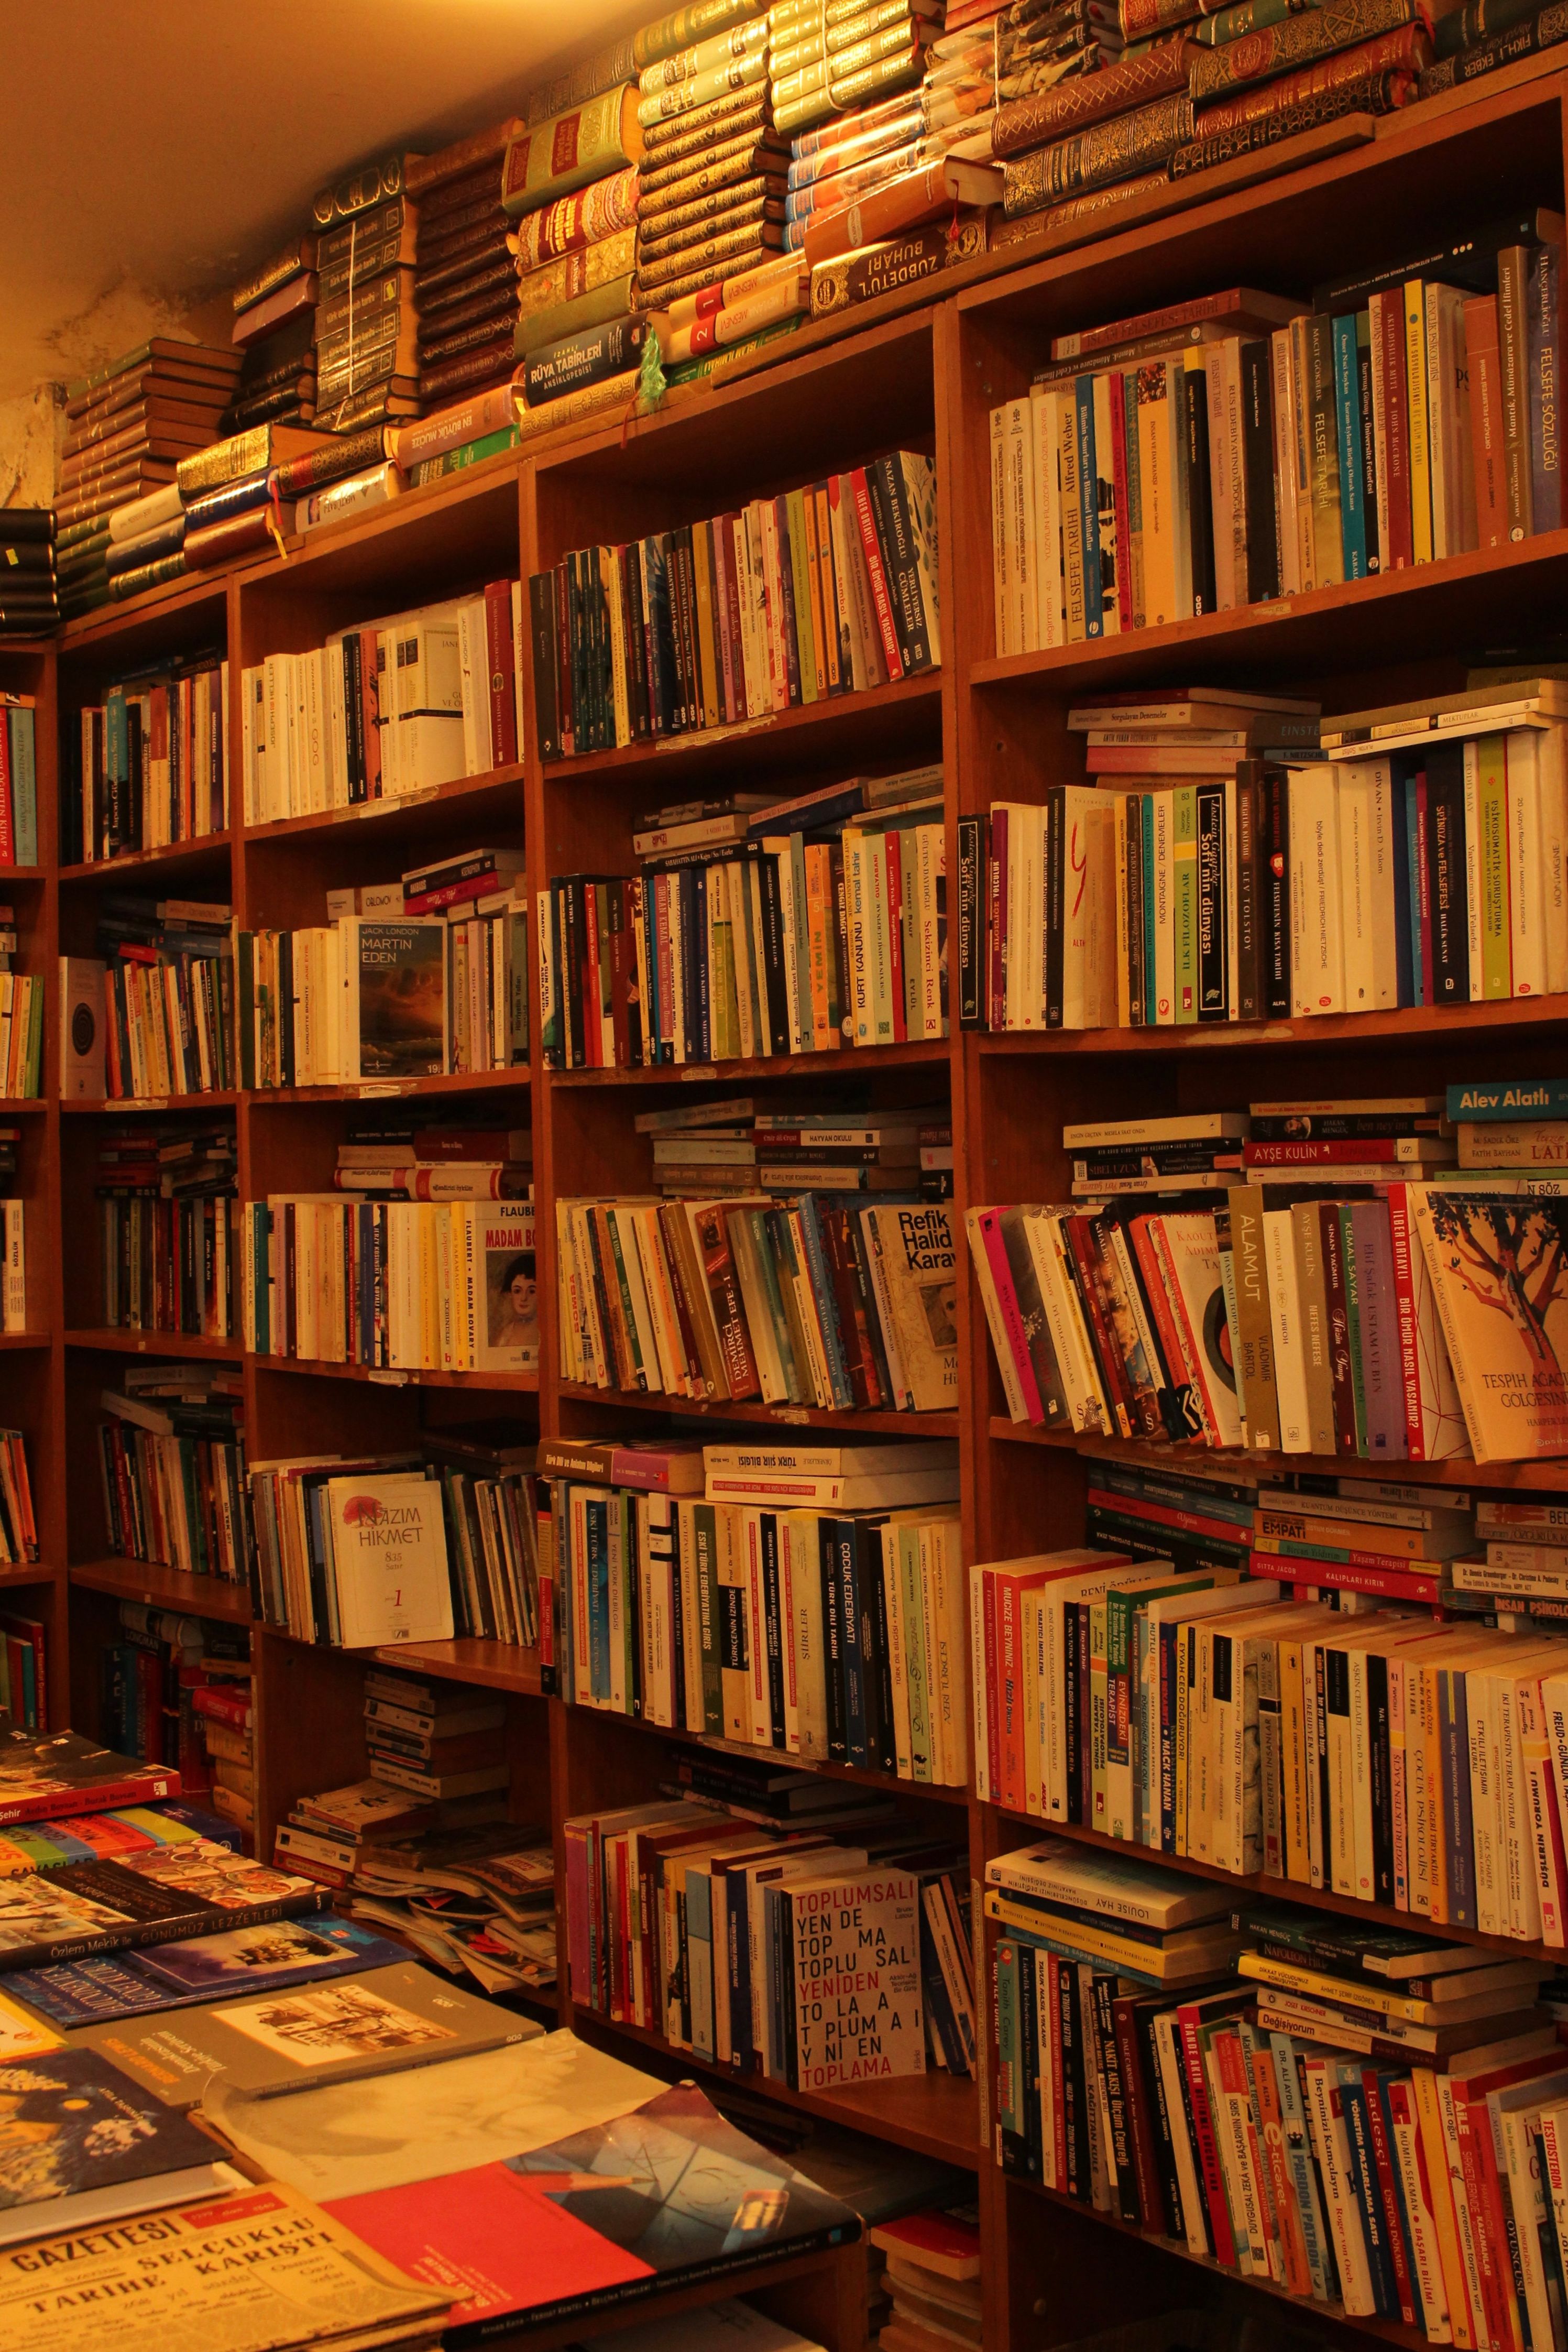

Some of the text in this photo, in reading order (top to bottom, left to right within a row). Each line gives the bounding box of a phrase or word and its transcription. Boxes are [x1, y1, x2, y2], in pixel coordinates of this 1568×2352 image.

[1465, 53, 1494, 77] EKBER
[696, 327, 708, 341] 2
[530, 363, 554, 384] RÜYA
[555, 340, 602, 372] TABİRLERİ
[543, 363, 592, 390] ANSİKLOPEDİSİ
[1540, 347, 1553, 401] FELSEFE
[1542, 404, 1558, 472] SÖZLÜĞÜ
[885, 462, 907, 559] NAZAN BEKİROĞLU
[1063, 413, 1083, 622] FELSEFE TARİHİ Alfred Weber
[898, 572, 914, 632] CÜMLELER
[1181, 792, 1190, 802] 83
[1158, 805, 1167, 925] DENEMELER MONTAIGNE
[366, 895, 392, 907] OBLOMOV
[362, 927, 420, 936] JACK LONDON
[852, 852, 866, 1009] KURT KANUNU kemal tahir
[1201, 898, 1213, 957] dünyası
[1243, 898, 1252, 951] TOLSTOY
[361, 938, 412, 950] MARTIN
[362, 952, 397, 964] EDEN
[811, 931, 825, 993] YEMİN
[924, 921, 935, 1009] Sekizinci Renk
[1460, 1088, 1549, 1108] Alev Alatlı
[1322, 1126, 1349, 1135] MENGÜÇ
[1089, 1163, 1139, 1176] SİBEL UZUN
[1255, 1145, 1318, 1161] AYŞE KULİN
[1539, 1182, 1560, 1195] SÖZ
[486, 1229, 522, 1248] MADAM
[900, 1211, 950, 1231] Refik
[902, 1231, 952, 1251] Halid
[1241, 1215, 1260, 1301] ALAMUT
[1095, 1222, 1121, 1307] KHALED HOSSEINI
[1344, 1222, 1359, 1306] KEMAL SAYAR
[1243, 1342, 1255, 1380] BARTOL
[1259, 1335, 1271, 1383] VLADIMIR
[1483, 1374, 1528, 1390] TESPİH
[738, 1455, 797, 1468] TÜRK ŞİİR BİLGİSİ
[1301, 1501, 1398, 1520] KUANTUM DÜŞÜNCE YÖNTEMİ
[359, 1527, 423, 1547] HİKMET
[386, 1552, 402, 1561] 835
[1352, 1553, 1406, 1569] Yaşam Terapisi
[394, 1590, 402, 1606] 1
[840, 1543, 857, 1644] ÇOCUK EDEBİYATI
[1326, 1573, 1385, 1588] KALIPLARI KIRIN
[1108, 1678, 1116, 1725] TERAPİST
[1119, 1680, 1129, 1742] EVİNİZDEKİ
[1161, 1739, 1172, 1811] MACK HANAN
[1416, 1751, 1428, 1882] ÇOCUK PSİKOLOJİSİ
[1531, 1779, 1549, 1887] DÜŞLERİN YORUMU
[797, 1879, 914, 1915] TOPLUMSALI
[1096, 1897, 1149, 1919] LOUISE HAY
[797, 1908, 863, 1936] YEN DE
[1249, 1923, 1292, 1942] HAKAN MENGÜÇ
[50, 1944, 85, 1960] Özlem
[87, 1938, 120, 1954] Mekik
[122, 1937, 132, 1946] ile
[140, 1922, 205, 1944] GÜNÜMÜZ
[798, 1927, 886, 1958] TOP MA
[1264, 1945, 1329, 1968] NAPOLEON HILL
[799, 1946, 911, 1981] TOPLU SAL
[1258, 1966, 1277, 1977] DİKKAT
[1278, 1971, 1309, 1985] VÜCUDUNUZ
[1268, 1975, 1298, 1987] KONUŞUYOR
[800, 1970, 880, 2002] YENİDEN
[802, 1992, 889, 2022] TO LA A
[1284, 1999, 1327, 2017] JOSEF KIRSCHNER
[802, 2027, 810, 2045] T
[826, 2016, 876, 2040] PLUM
[892, 2011, 902, 2030] A
[1263, 2014, 1315, 2037] Değişiyorum
[803, 2048, 812, 2066] Y
[859, 2036, 882, 2055] EN
[1185, 2023, 1202, 2086] HANDE AKIN
[803, 2056, 892, 2088] TOPLAMA
[1087, 2084, 1100, 2174] KAĞITTAN KULE
[1455, 2101, 1471, 2136] AİLE
[1264, 2121, 1287, 2207] e-ticaret
[1542, 2120, 1563, 2190] TESTOSTERON
[1315, 2078, 1331, 2131] Beyninizi
[1323, 2132, 1341, 2200] Kamçılayın
[1335, 2207, 1345, 2235] Roger
[1344, 2255, 1353, 2284] Oech
[1292, 2154, 1320, 2269] PARDON PATRON
[1400, 2131, 1435, 2306] MÜMİN SEKMAN BAŞARI BİLİMİ
[137, 2218, 315, 2272] SELÇUKLU
[1384, 2189, 1396, 2227] ÜSTÜN
[1390, 2230, 1405, 2278] DÖKMEN
[1476, 2216, 1492, 2278] KAZANANLAR
[195, 2233, 335, 2276] KARIŞTI
[1460, 2205, 1484, 2313] evrenden torpilim var!
[1506, 2219, 1524, 2298] OYUNCUSU
